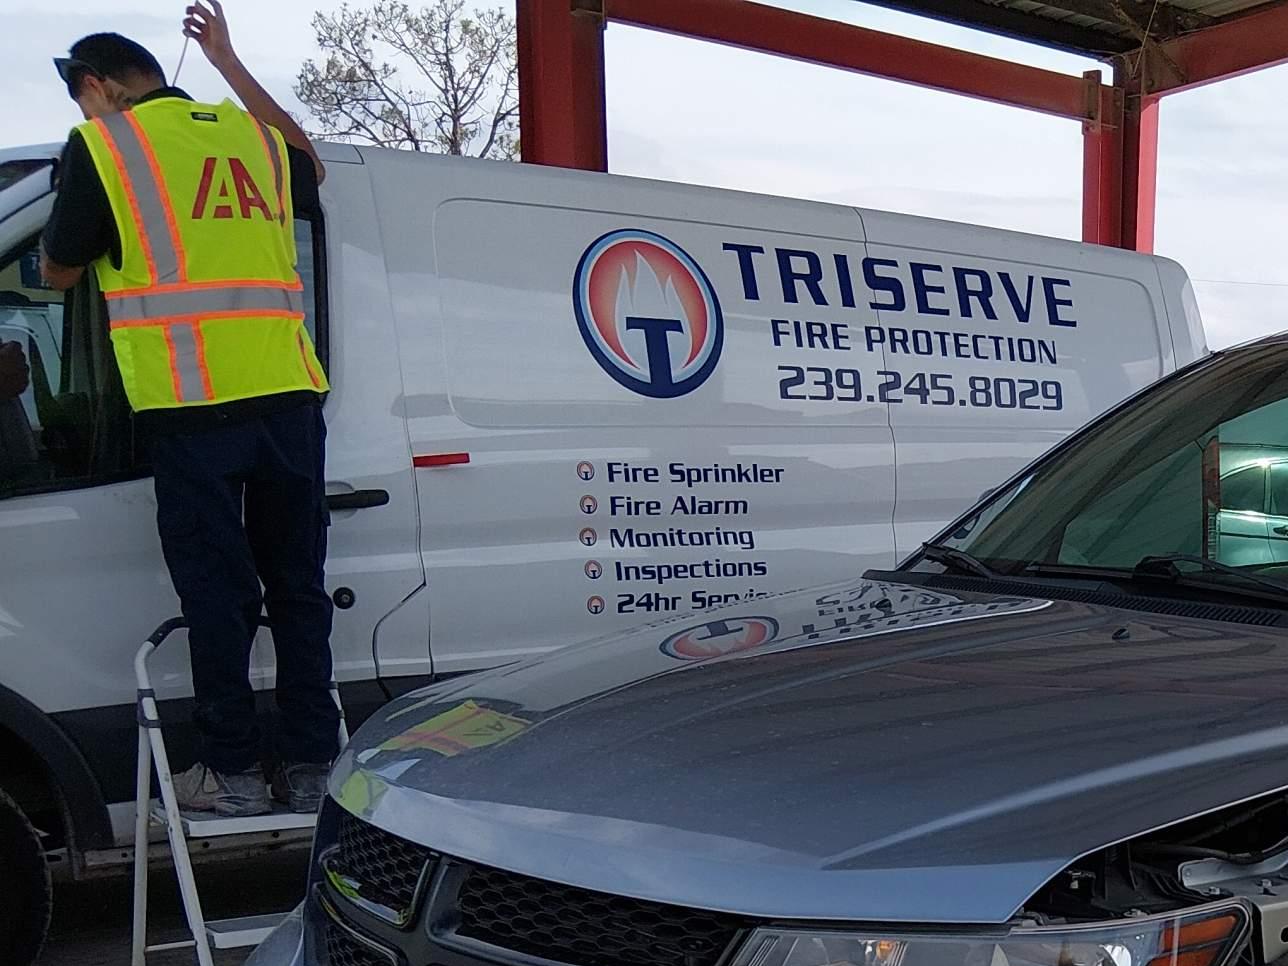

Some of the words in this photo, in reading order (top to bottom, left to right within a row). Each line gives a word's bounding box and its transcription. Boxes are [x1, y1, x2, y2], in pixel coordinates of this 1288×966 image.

[721, 241, 1079, 328] TRISERVE
[771, 319, 850, 351] FIRE
[865, 325, 1058, 366] PROTECTION
[777, 365, 1063, 411] 239.245.8029
[606, 463, 659, 484] Fire
[669, 463, 785, 488] Sprinkler
[609, 496, 661, 517] Fire
[671, 496, 749, 516] Alarm
[609, 526, 755, 550] Monitoring
[614, 559, 768, 585] Inspections
[616, 592, 682, 614] 24hr
